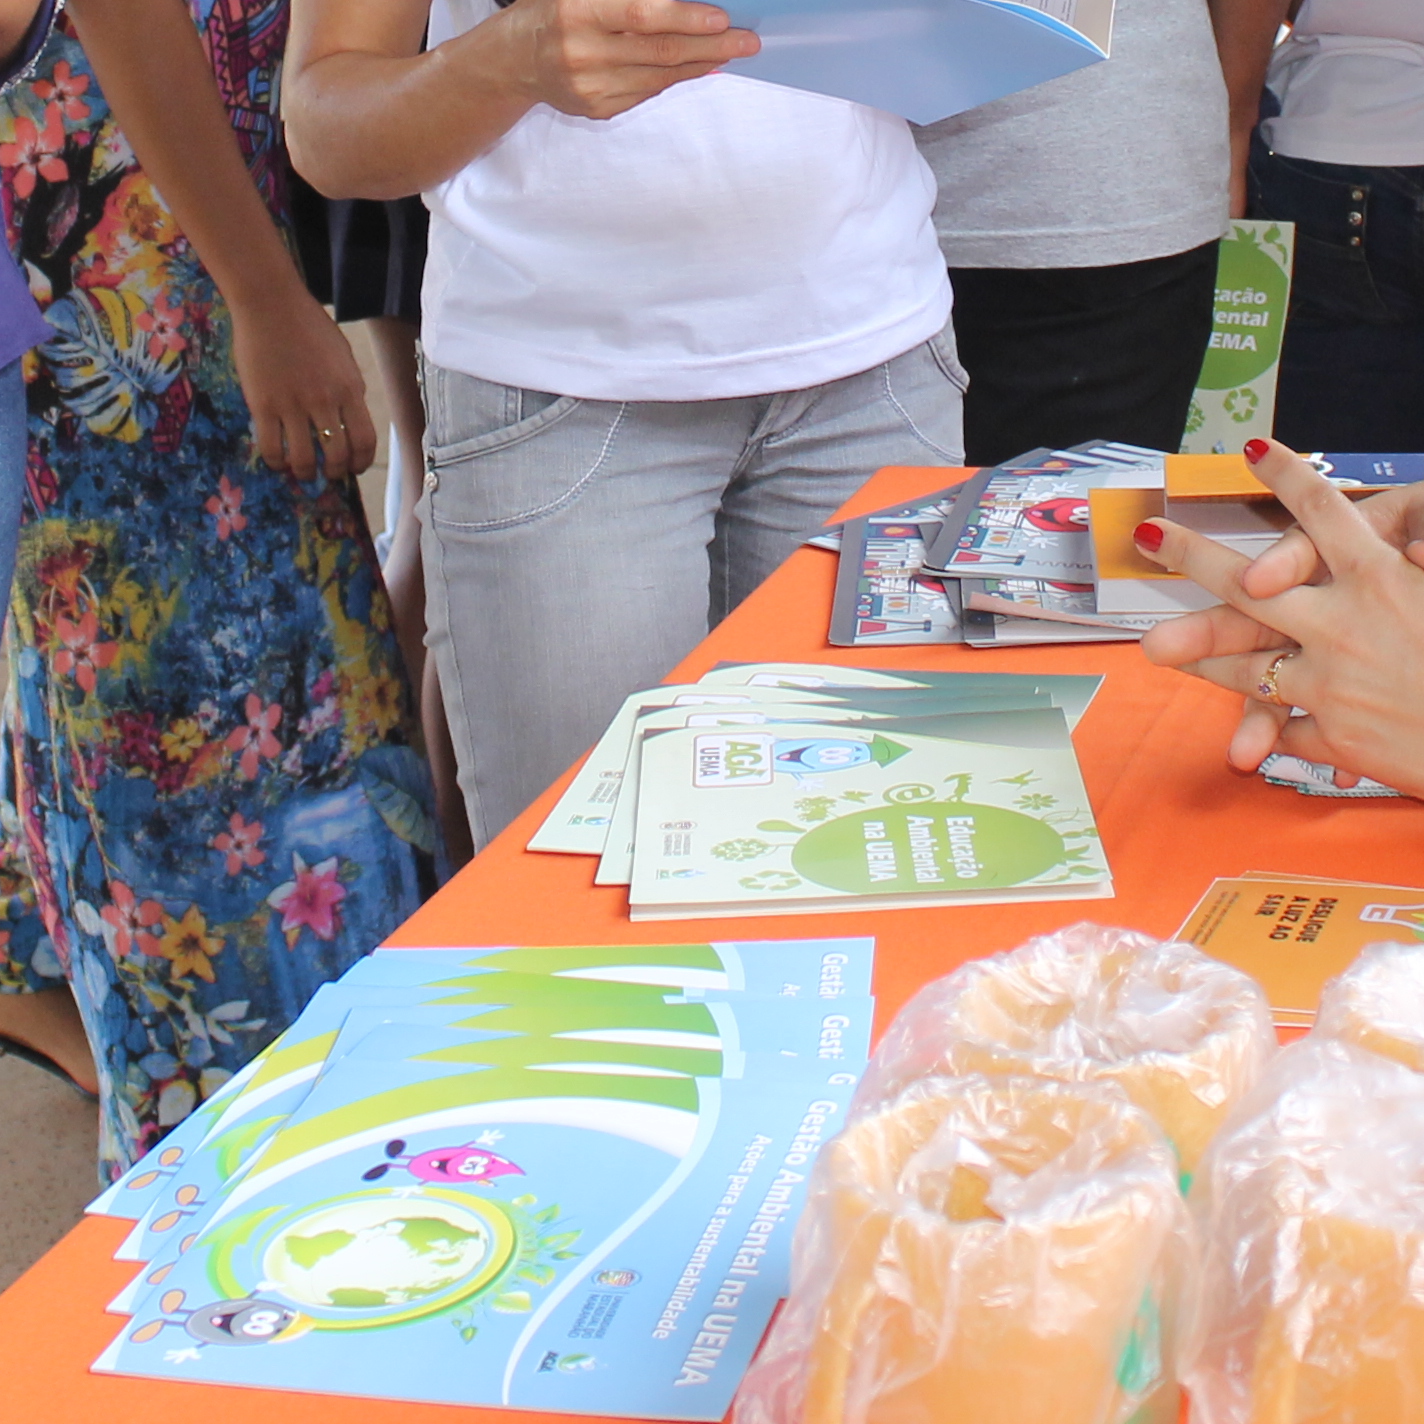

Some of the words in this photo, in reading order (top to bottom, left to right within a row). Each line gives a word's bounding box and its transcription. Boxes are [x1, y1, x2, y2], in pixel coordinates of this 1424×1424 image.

[1208, 332, 1258, 352] EMA
[699, 747, 720, 778] UEMA
[863, 822, 887, 840] na
[906, 815, 945, 884] Ambiental
[945, 815, 986, 880] Educação
[866, 840, 898, 883] UEMA
[1295, 897, 1339, 943] DESLIGUE
[738, 1132, 774, 1174] Ações
[784, 1100, 838, 1167] Gestão
[723, 1174, 750, 1206] para
[730, 1168, 805, 1276] Ambiental
[652, 1217, 727, 1341] sustentabilidade
[713, 1279, 747, 1309] na
[674, 1314, 738, 1387] UEMA
